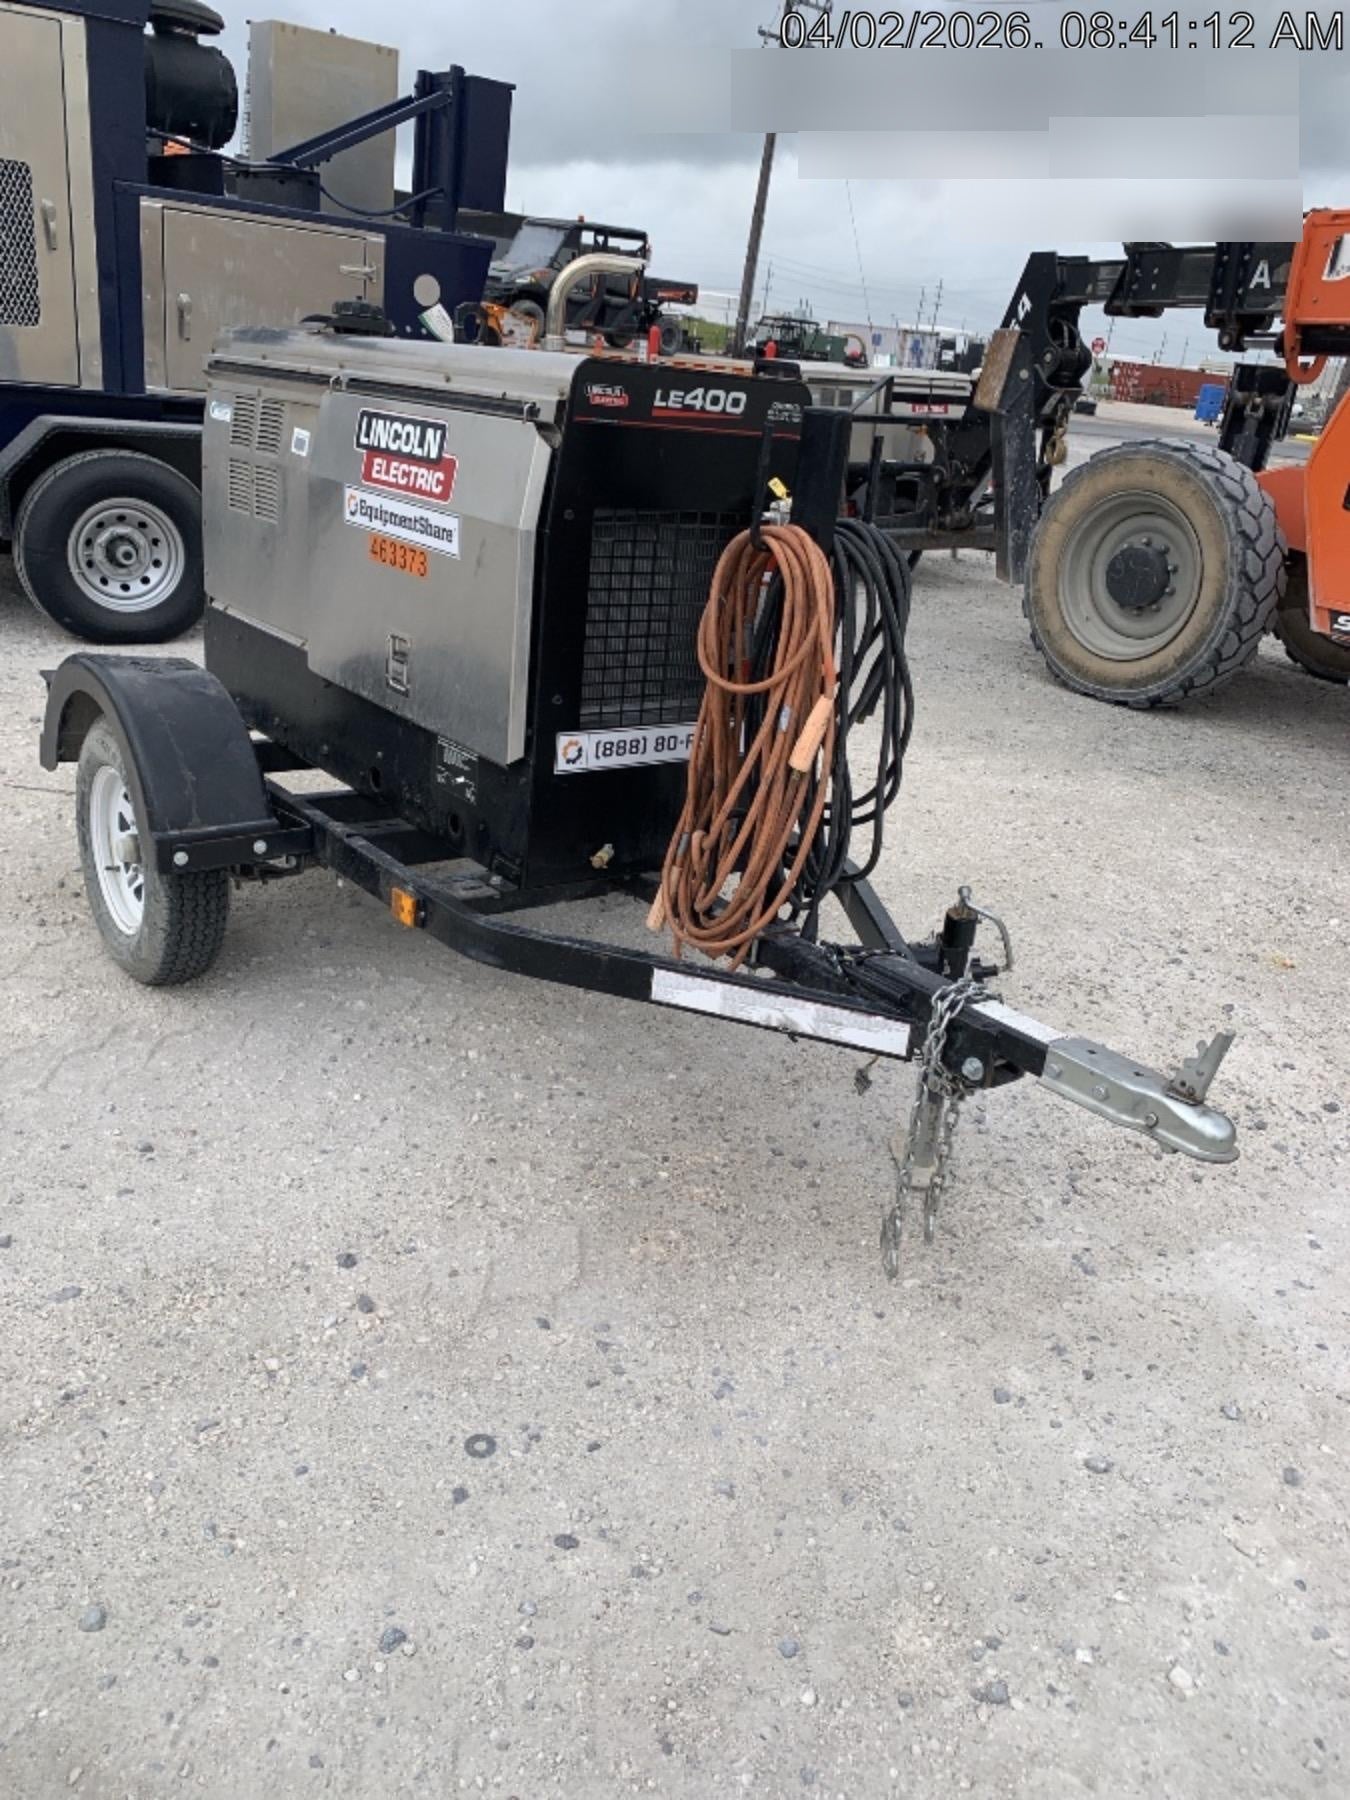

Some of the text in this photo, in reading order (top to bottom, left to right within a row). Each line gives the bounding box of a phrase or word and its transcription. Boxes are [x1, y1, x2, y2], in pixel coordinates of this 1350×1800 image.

[653, 386, 747, 415] LE400
[359, 416, 443, 460] LINCOLN
[371, 457, 446, 495] ELECTRIC
[359, 498, 454, 544] EquipmentShare
[370, 537, 428, 578] 463373
[595, 735, 647, 761] (888)
